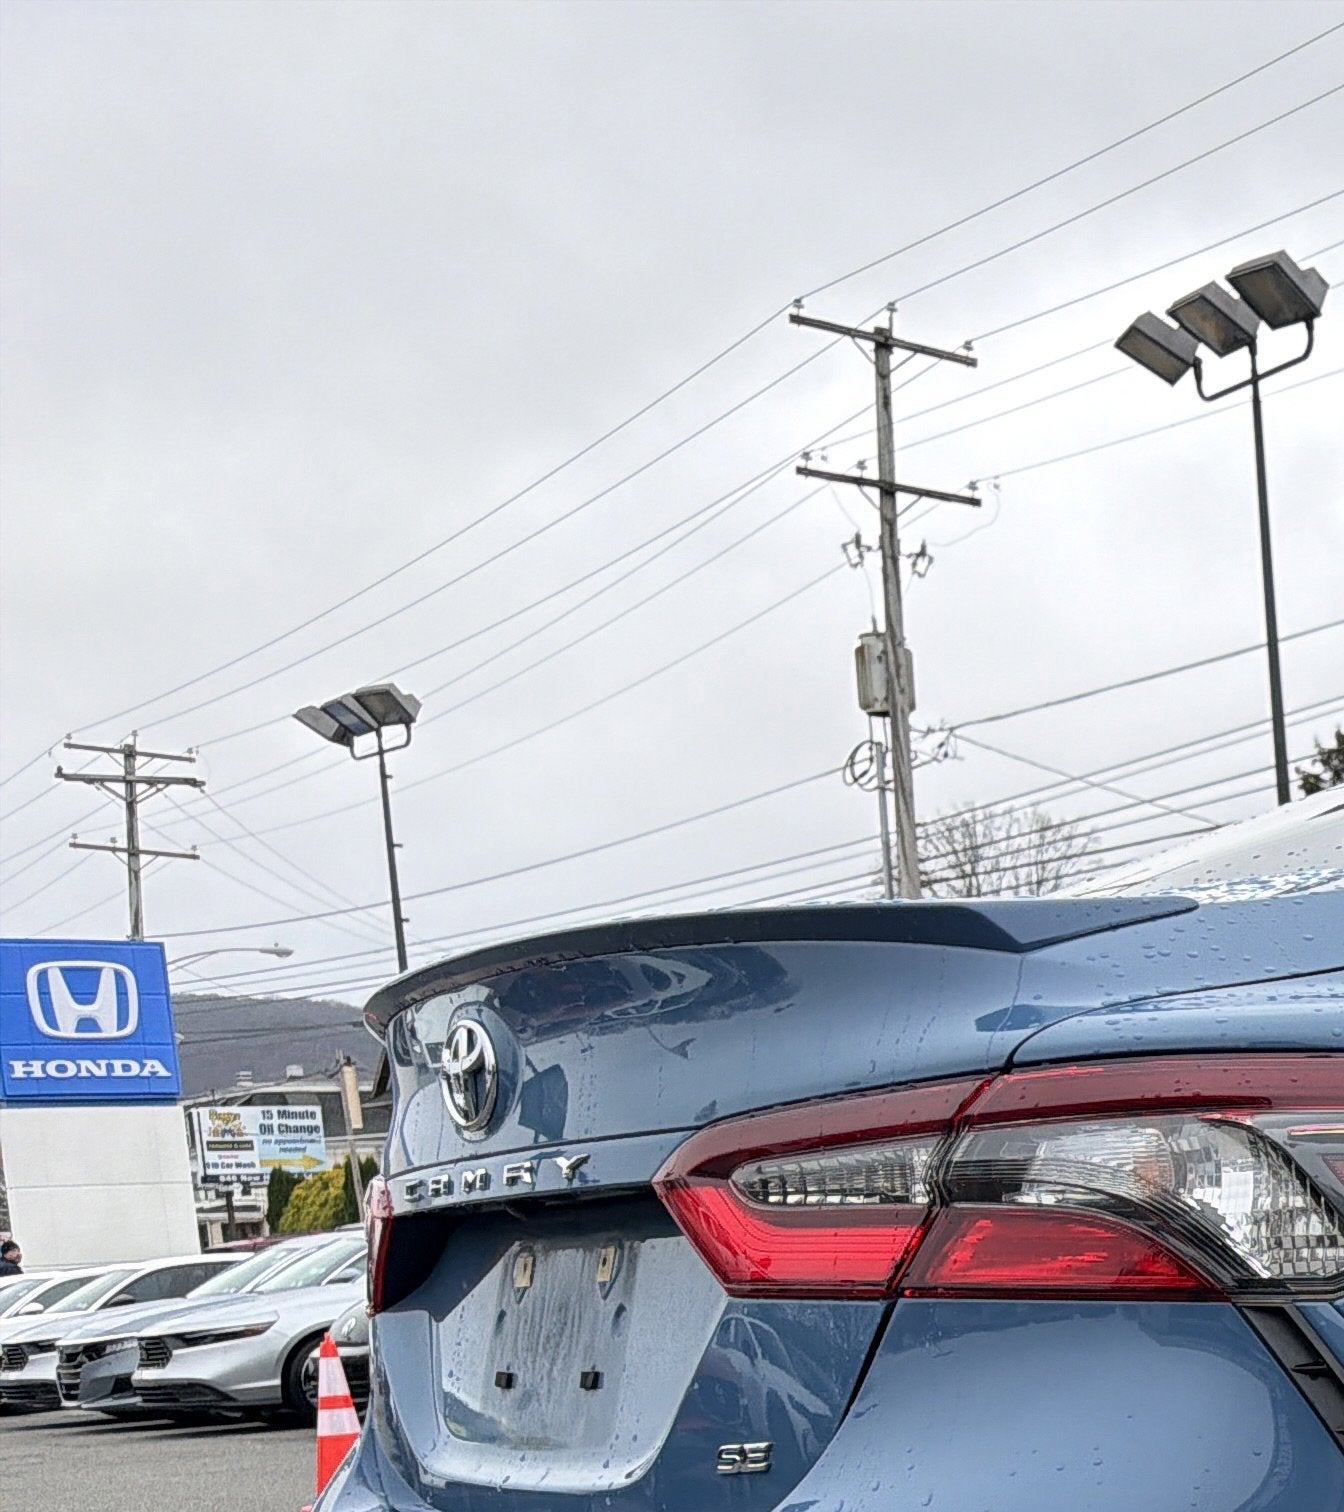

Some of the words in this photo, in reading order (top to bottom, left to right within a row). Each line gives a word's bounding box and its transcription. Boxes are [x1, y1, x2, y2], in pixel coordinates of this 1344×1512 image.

[9, 1059, 171, 1079] HONDA
[261, 1109, 273, 1120] 15
[277, 1109, 317, 1120] Minute
[259, 1123, 274, 1135] Oil
[278, 1123, 320, 1135] Change
[404, 1153, 591, 1202] CAMRY
[717, 1441, 773, 1475] SE
